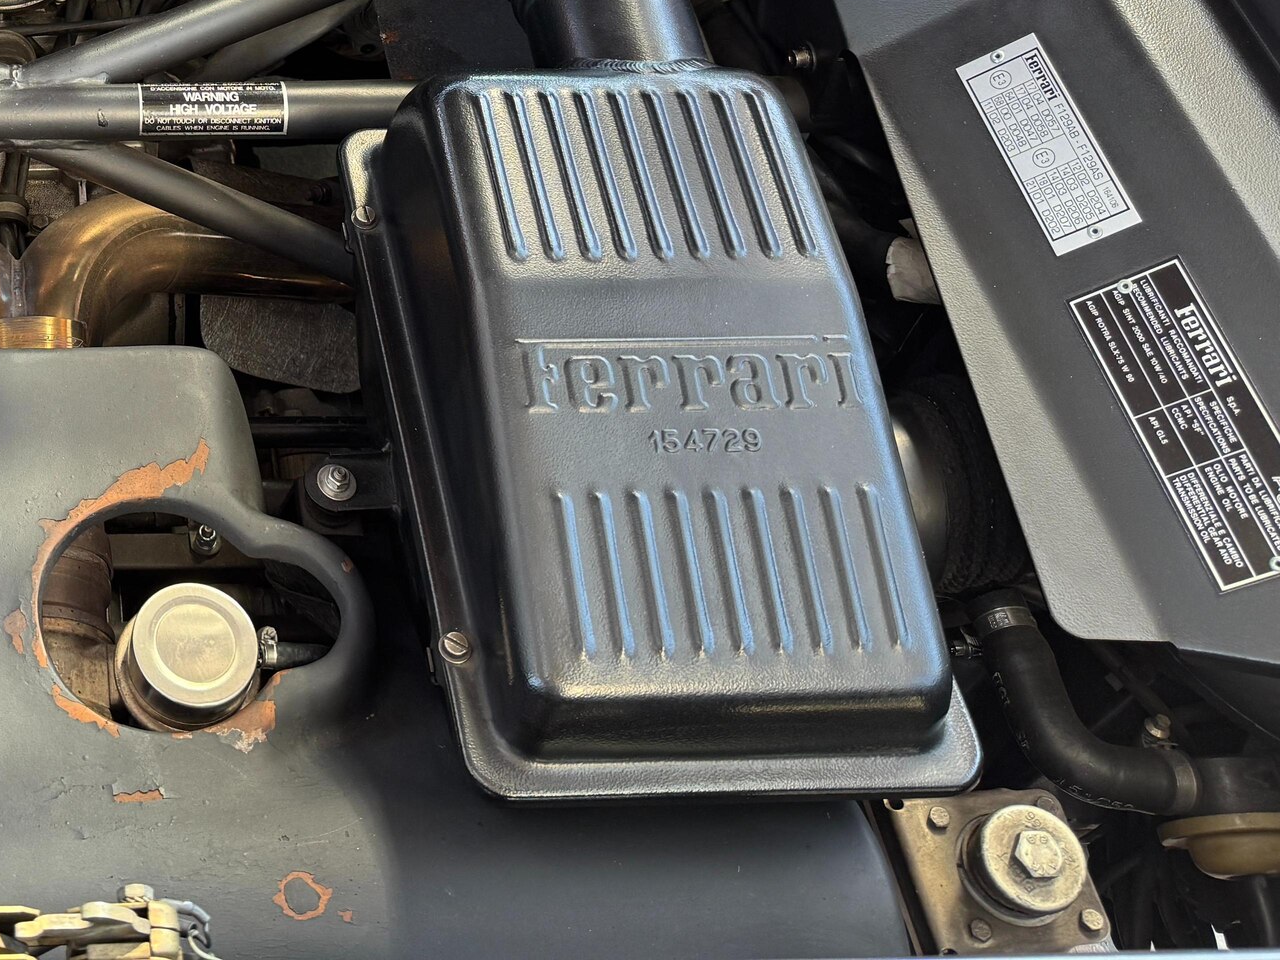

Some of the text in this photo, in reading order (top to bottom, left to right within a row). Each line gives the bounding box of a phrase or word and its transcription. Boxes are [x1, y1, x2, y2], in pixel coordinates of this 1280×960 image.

[170, 104, 258, 116] HIGH VOLTAGE
[183, 92, 240, 102] WARNING
[1023, 52, 1061, 102] Ferrari
[1052, 102, 1080, 139] F129AB
[1075, 143, 1104, 181] F129AS
[1085, 299, 1099, 317] AGIP
[1094, 316, 1112, 341] ROTRA
[1111, 288, 1125, 306] AGIP
[1121, 307, 1136, 325] SINT
[1130, 324, 1145, 342] 2000
[1140, 342, 1154, 357] SAE
[1139, 278, 1203, 384] LUBRIFICANTI RACCOMANDATI
[1173, 302, 1237, 387] Ferrari
[515, 334, 864, 414] Ferrari
[1120, 364, 1130, 373] W
[1124, 372, 1135, 383] 90
[1159, 336, 1189, 380] LUBRICANTS
[1147, 415, 1169, 445] API GL5
[1170, 406, 1188, 430] CCMC
[1180, 403, 1193, 418] API
[1192, 396, 1231, 454] SPECIFICATIONS
[1207, 400, 1237, 443] SPECIFICHE
[648, 427, 763, 455] 154729
[1202, 466, 1234, 512] ENGINE OIL
[1212, 462, 1249, 519] OLIO MOTORE
[1227, 457, 1246, 481] PARTS
[1241, 482, 1253, 494] TO
[1247, 493, 1260, 505] BE
[1237, 453, 1255, 475] PARTI
[1250, 476, 1263, 488] DA
[1170, 477, 1211, 543] TRANSMISSION OIL
[1178, 474, 1233, 565] DIFFERENTIAL GEAR AND
[1186, 471, 1222, 528] DIFFERENZIALE
[1221, 536, 1244, 568] CAMBIO
